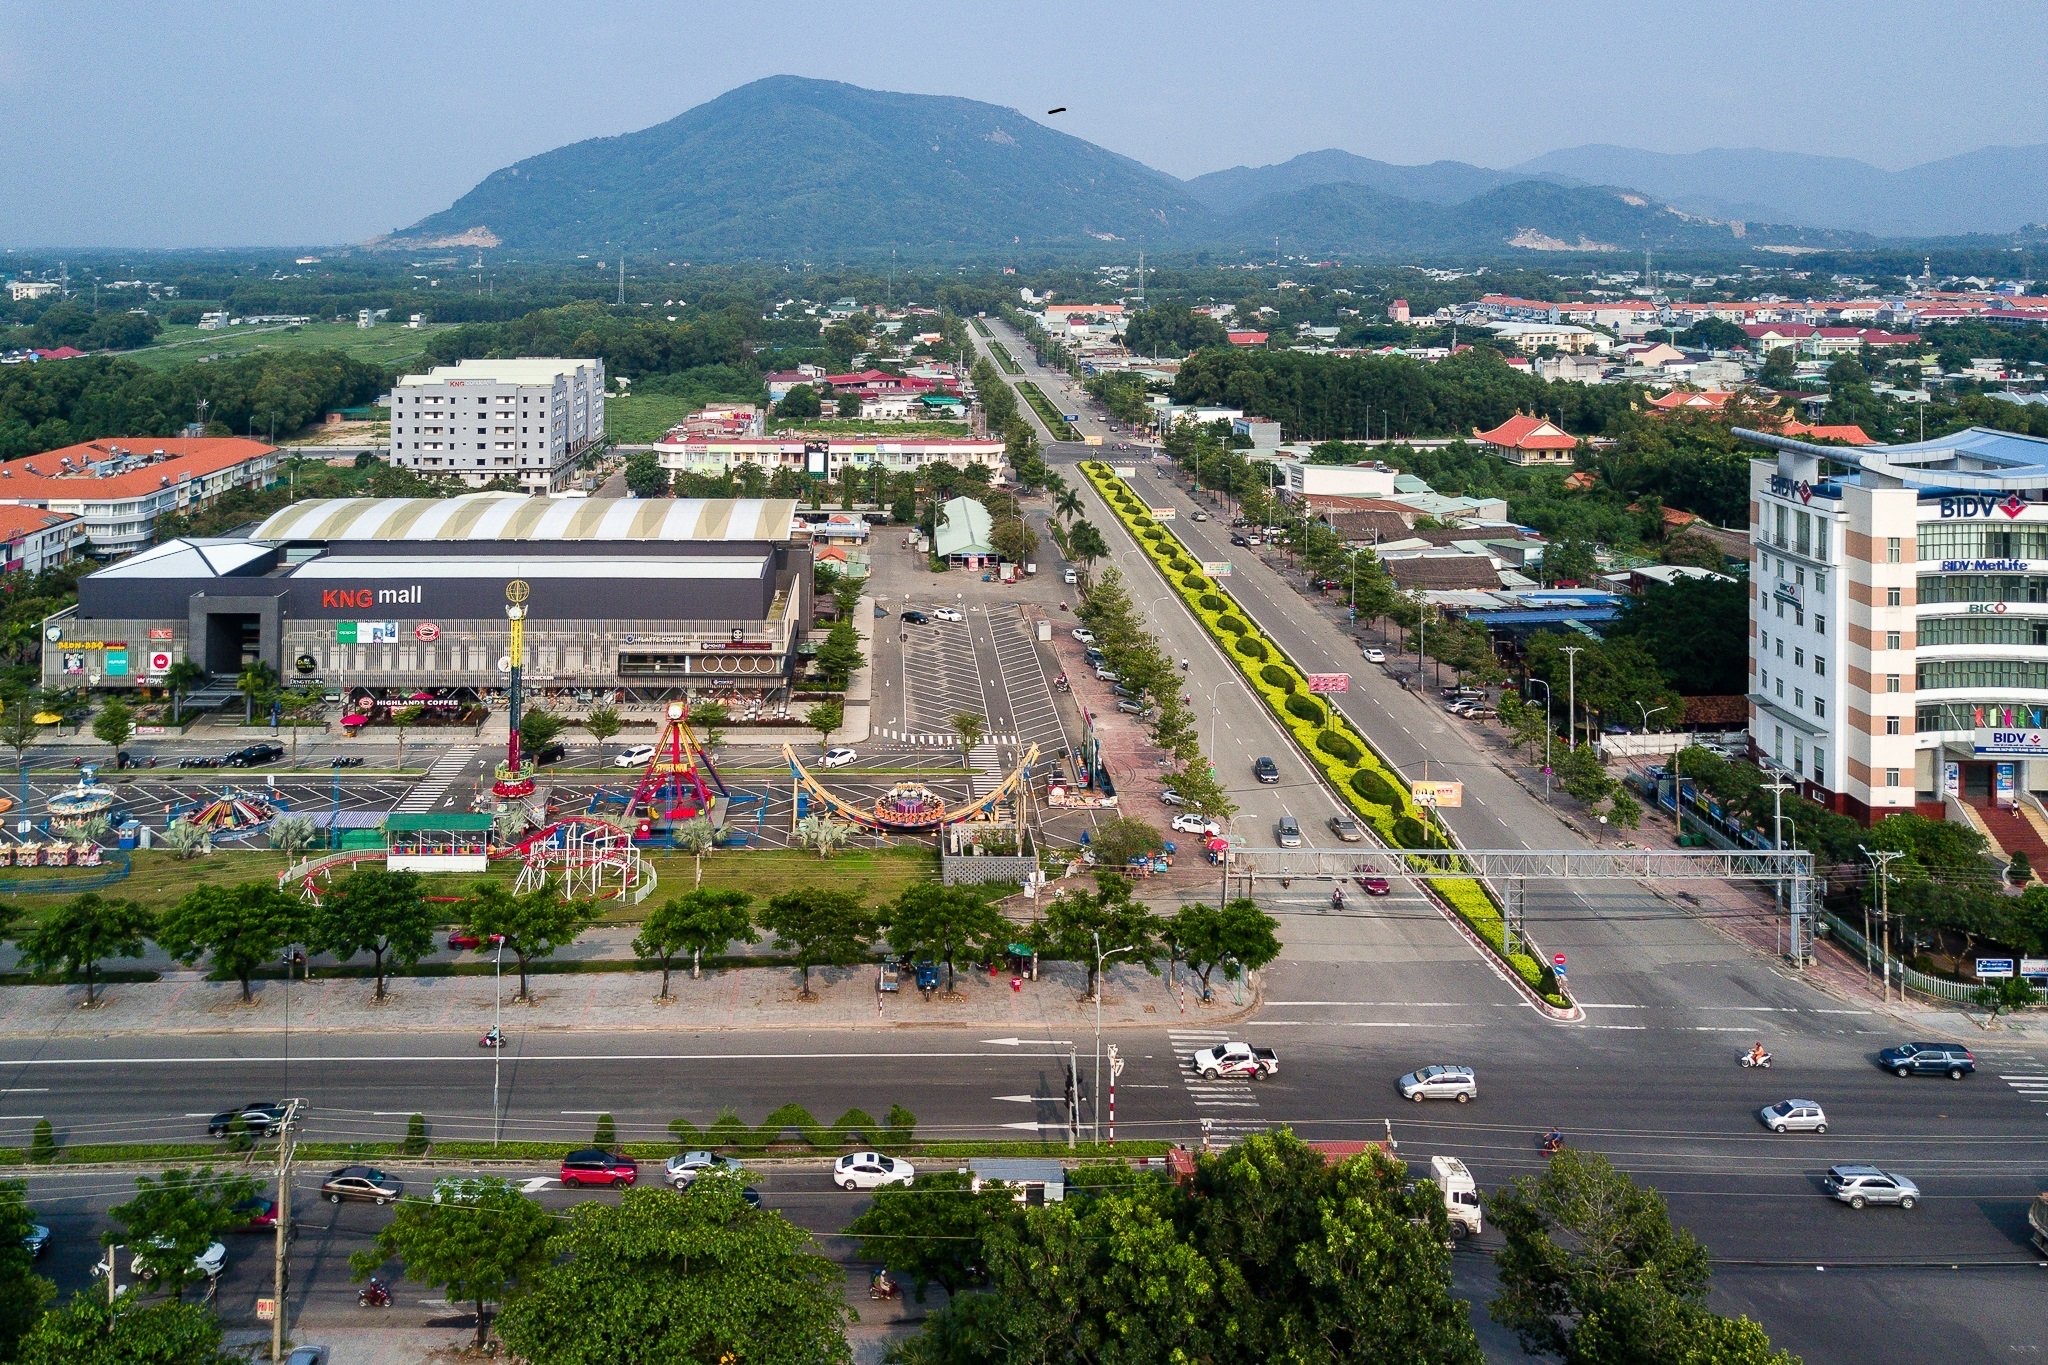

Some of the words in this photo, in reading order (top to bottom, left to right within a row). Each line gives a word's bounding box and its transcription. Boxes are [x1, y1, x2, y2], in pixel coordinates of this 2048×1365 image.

[1771, 474, 1800, 499] BIDV
[1940, 497, 1997, 518] BIDV
[1942, 560, 1970, 571] BIDV
[1974, 559, 2028, 571] MetLife
[323, 589, 373, 608] KNG
[378, 585, 422, 604] mall
[1993, 732, 2026, 743] BIDV
